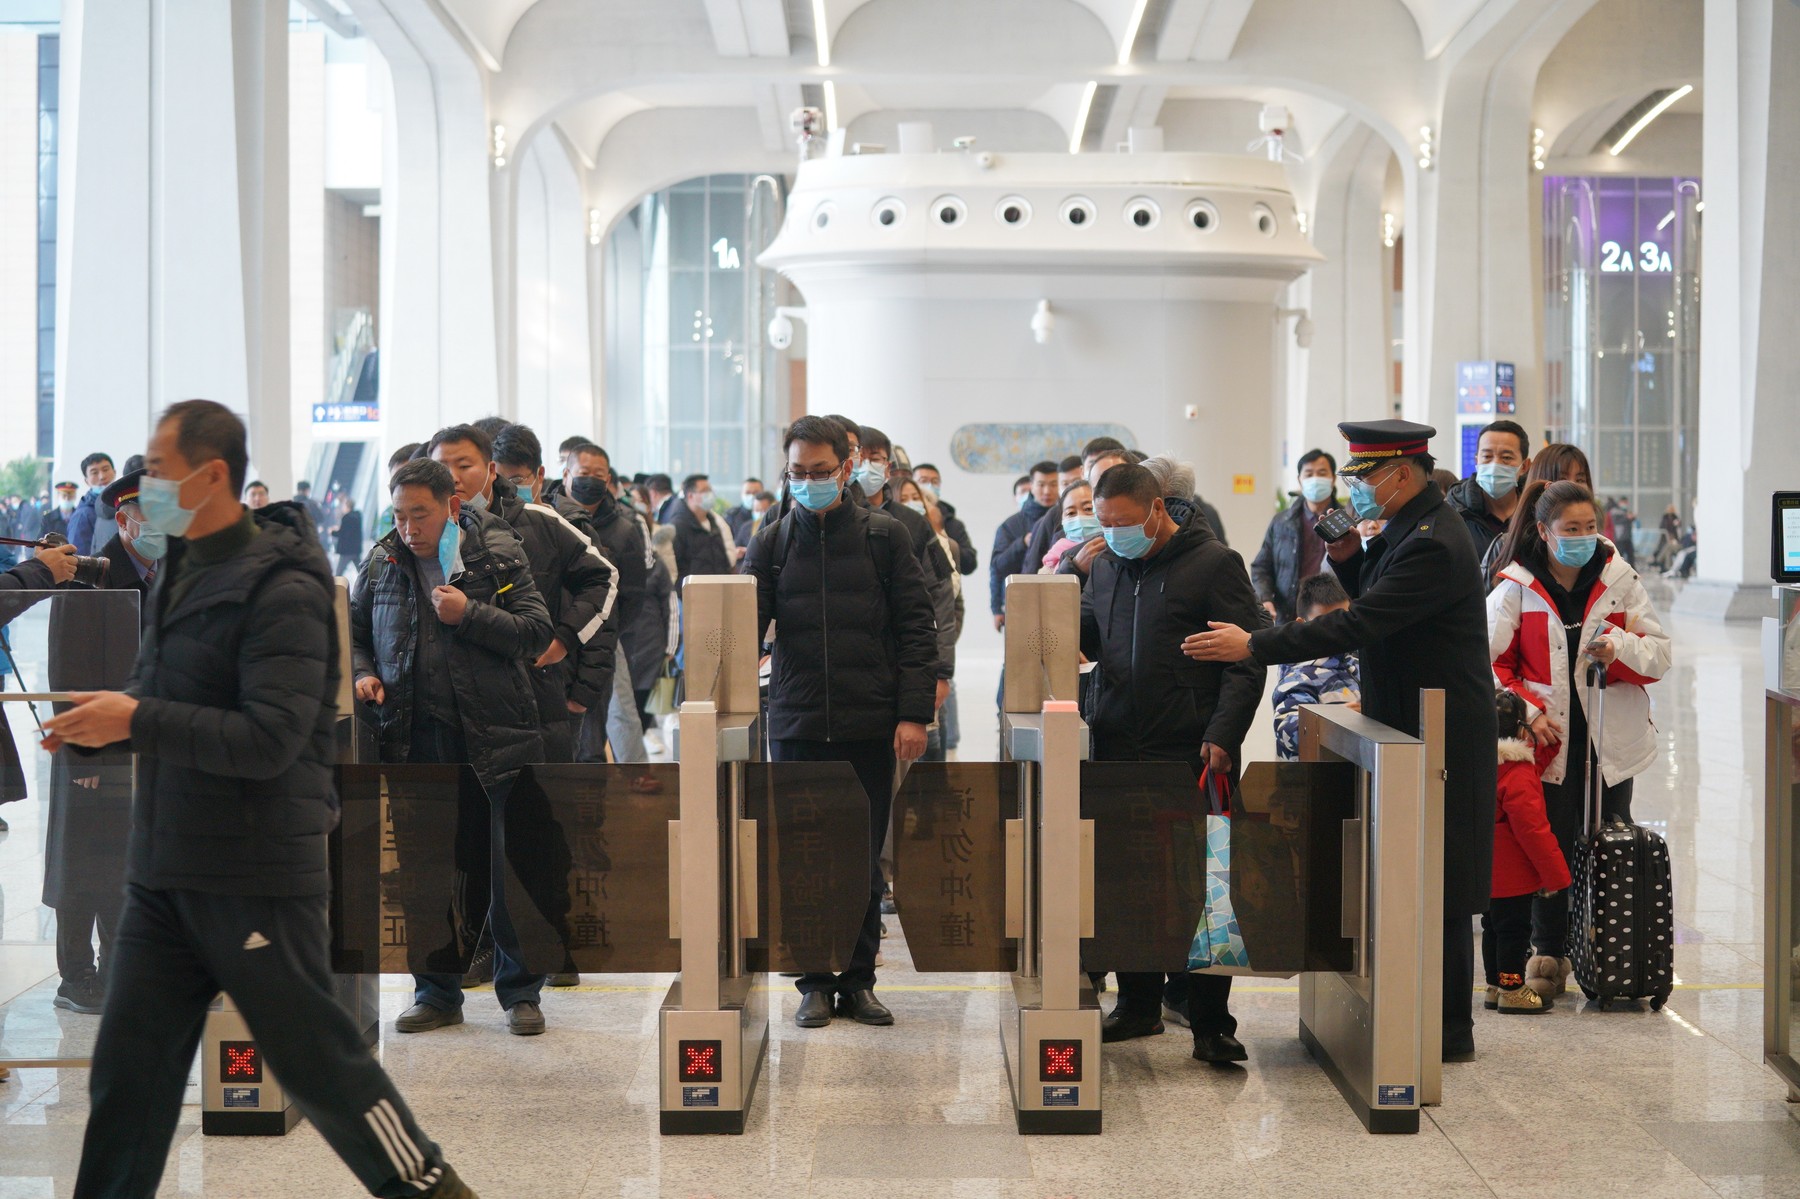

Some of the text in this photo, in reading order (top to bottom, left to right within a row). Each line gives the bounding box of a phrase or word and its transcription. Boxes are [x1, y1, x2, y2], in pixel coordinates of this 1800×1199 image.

[712, 237, 740, 269] 1A
[1601, 241, 1672, 272] 2A 3A
